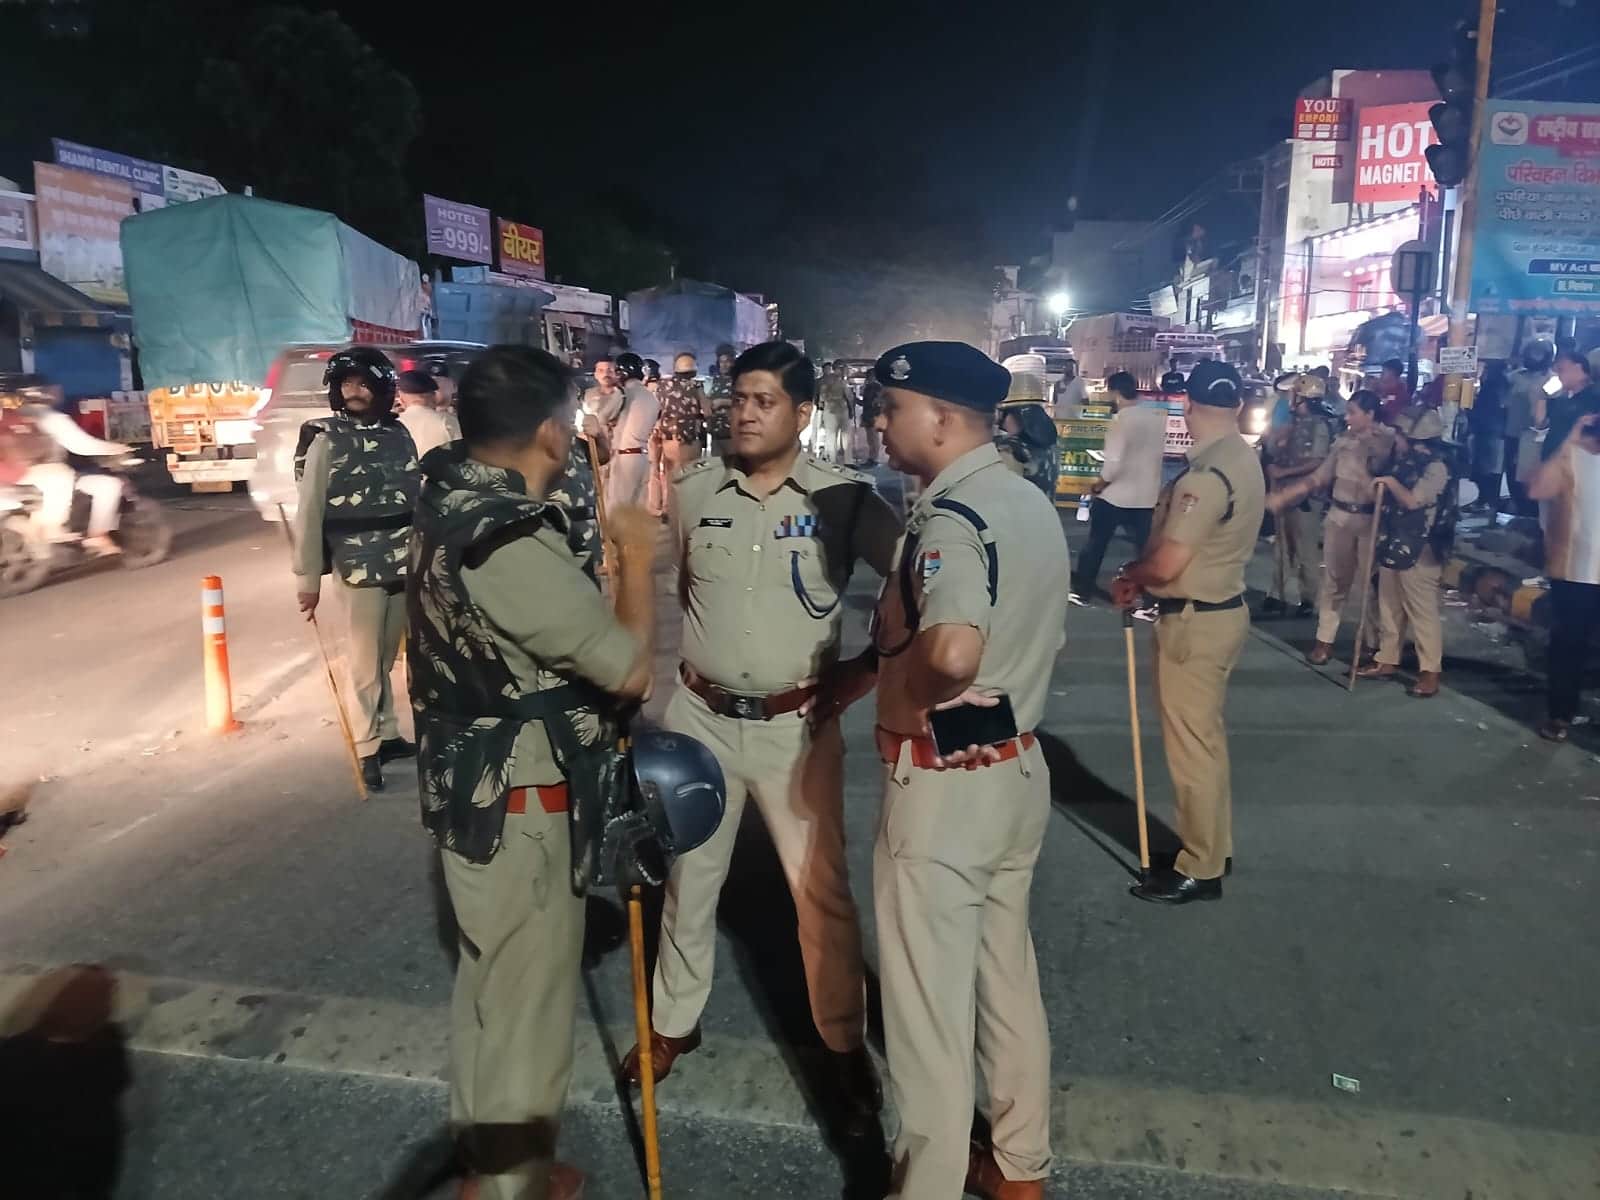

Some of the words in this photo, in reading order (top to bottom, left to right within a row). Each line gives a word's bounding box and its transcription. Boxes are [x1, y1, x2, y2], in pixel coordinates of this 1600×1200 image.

[1360, 120, 1441, 160] HOT
[1359, 162, 1422, 186] MAGNET
[437, 207, 480, 226] HOTEL
